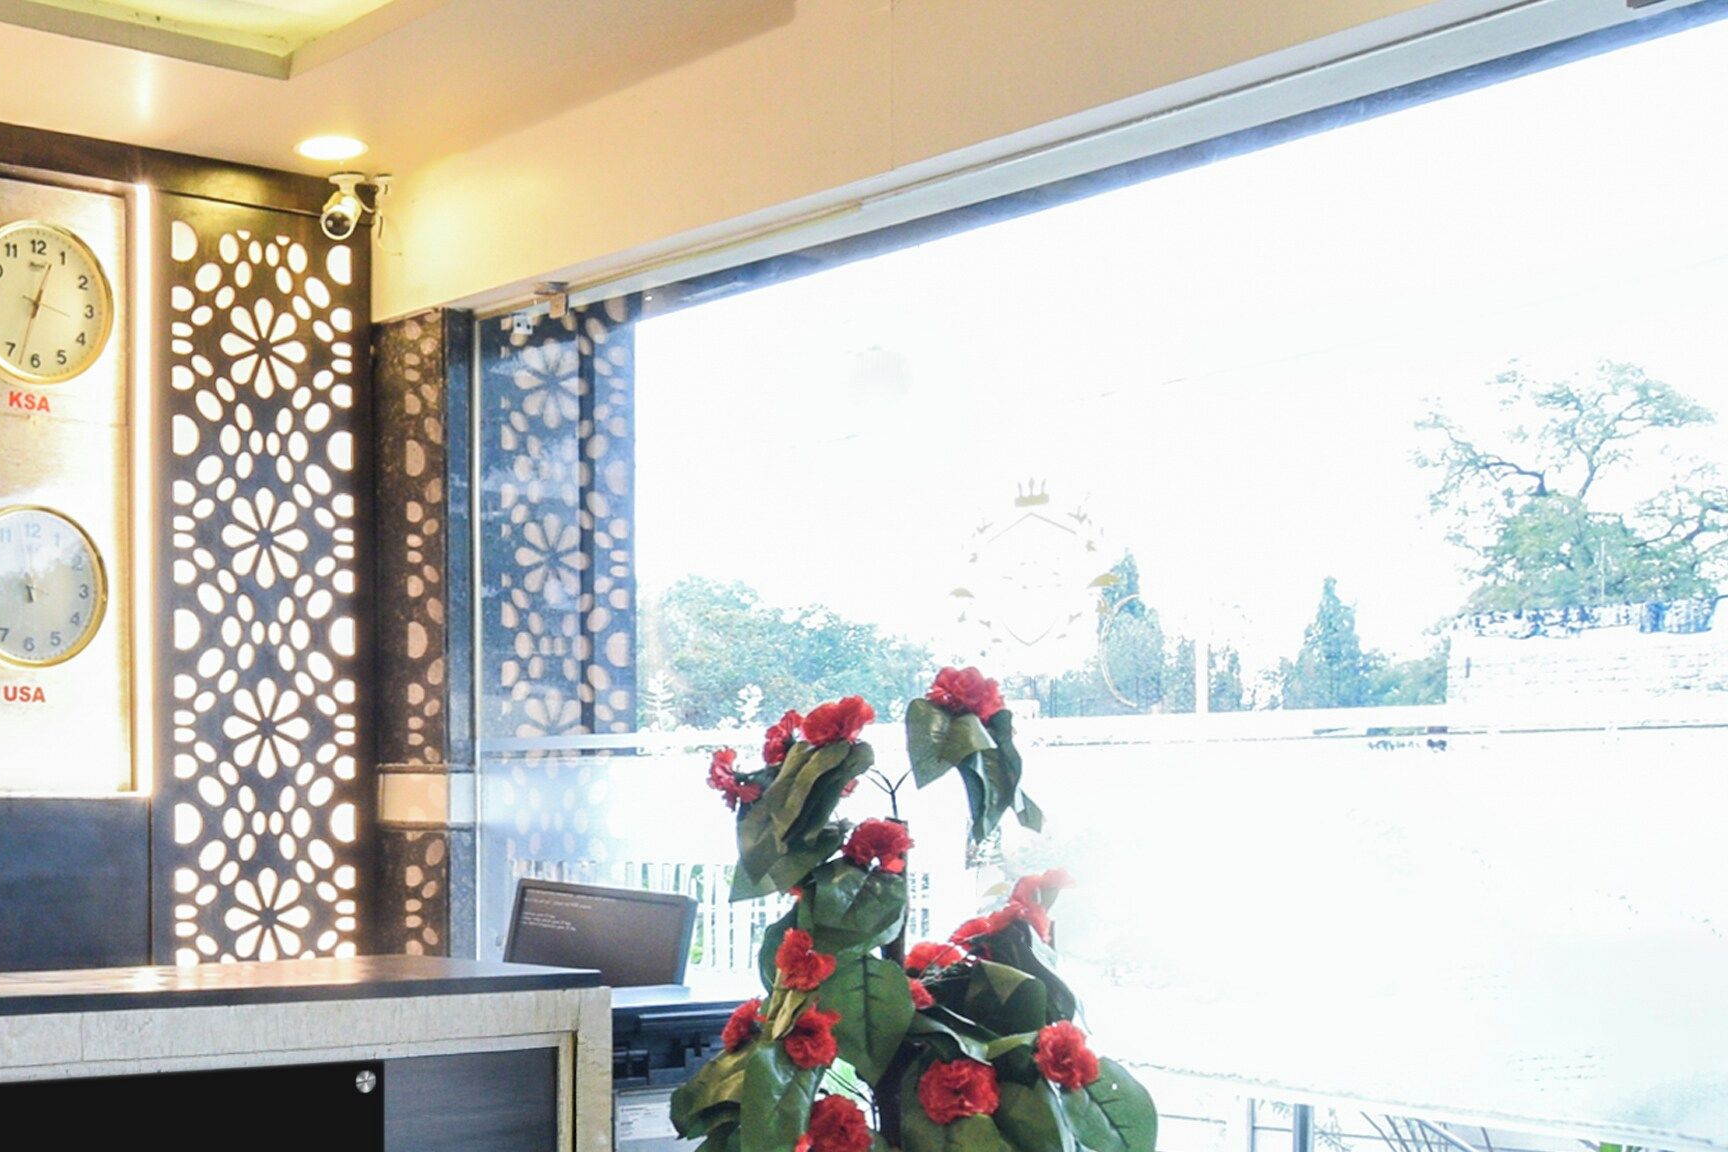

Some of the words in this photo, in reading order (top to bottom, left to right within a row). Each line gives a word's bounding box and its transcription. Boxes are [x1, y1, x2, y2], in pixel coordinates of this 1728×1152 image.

[5, 243, 18, 257] 11
[30, 240, 47, 255] 12
[60, 252, 66, 265] 1
[78, 276, 88, 290] 2
[85, 305, 94, 319] 3
[76, 332, 85, 346] 4
[6, 342, 16, 356] 7
[30, 354, 41, 368] 6
[57, 350, 67, 364] 5
[8, 391, 50, 411] KSA
[24, 523, 41, 538] 12
[79, 584, 89, 599] 3
[70, 612, 80, 625] 4
[23, 637, 35, 652] 6
[50, 631, 61, 646] 5
[3, 685, 46, 702] USA
